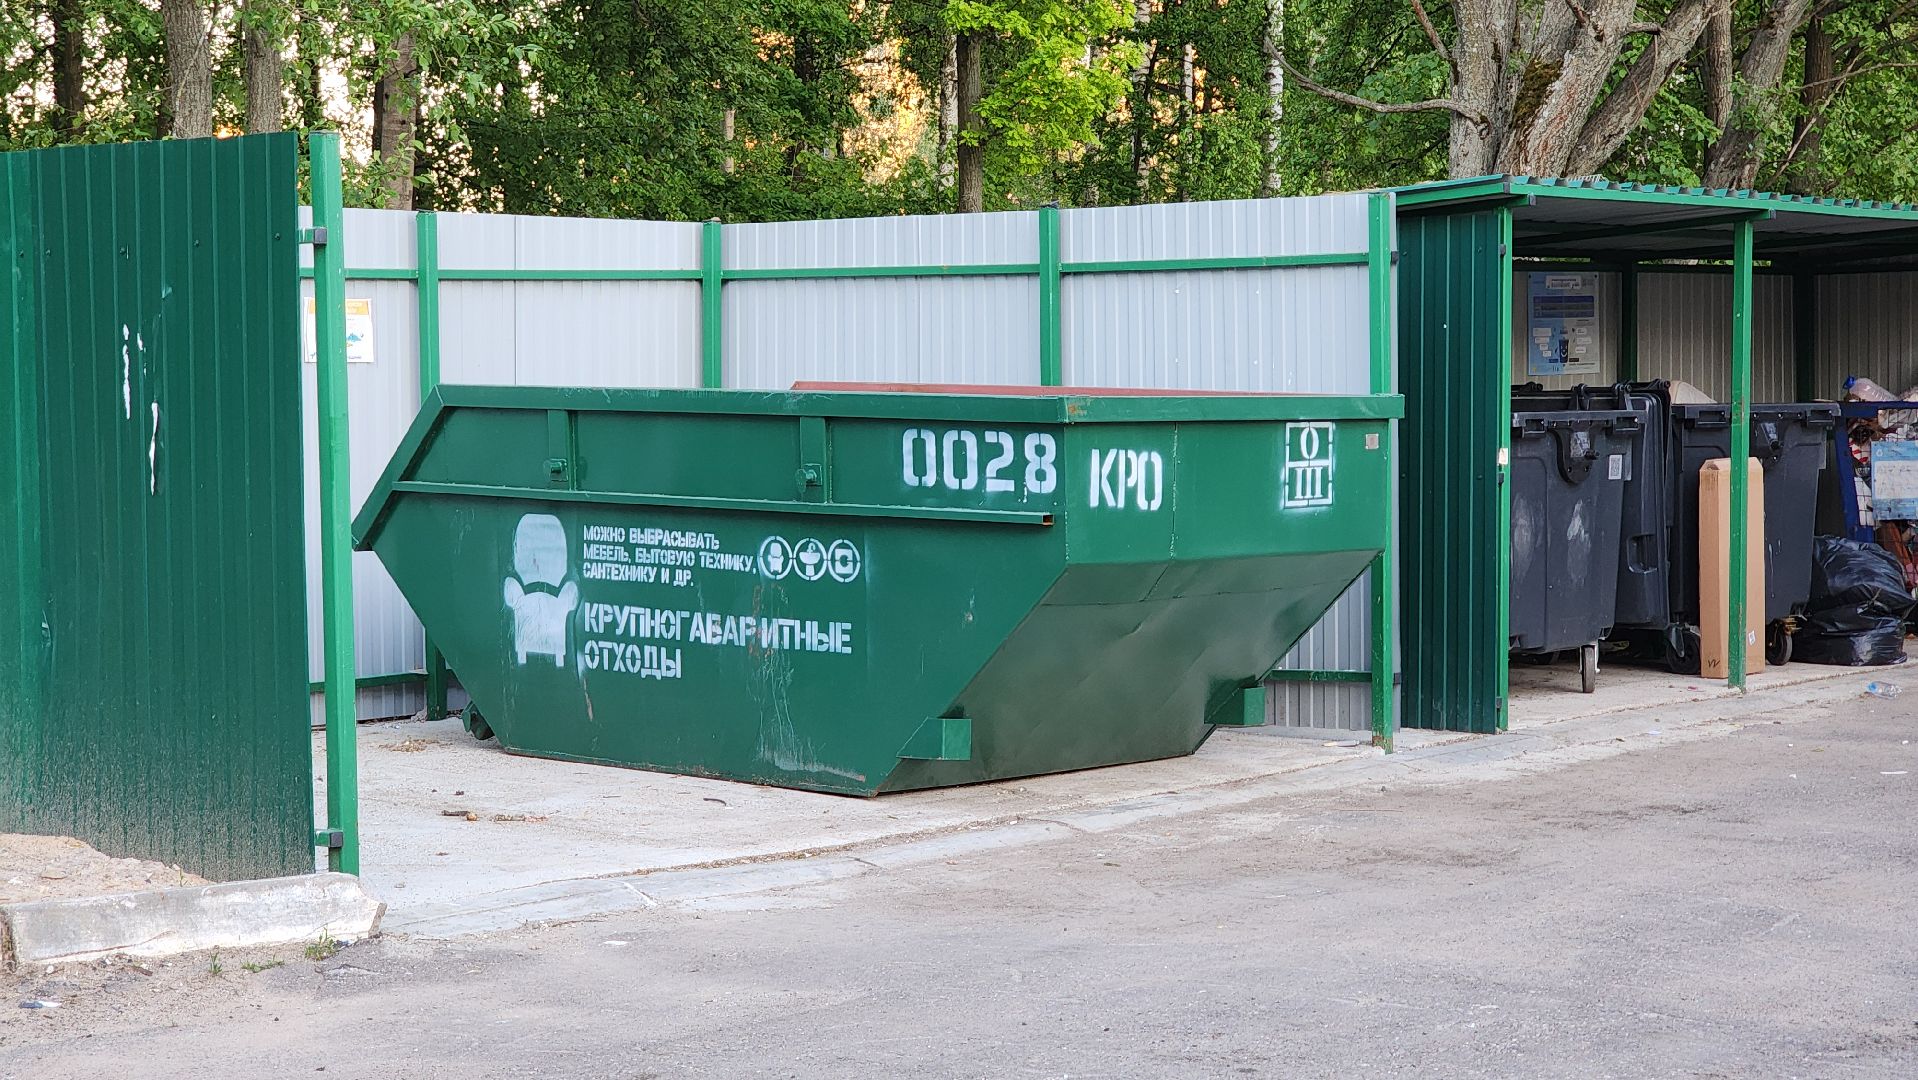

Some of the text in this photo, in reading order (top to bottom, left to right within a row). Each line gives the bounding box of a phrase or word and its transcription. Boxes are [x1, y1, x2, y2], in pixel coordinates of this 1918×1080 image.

[902, 428, 1057, 494] 0028
[1089, 448, 1162, 511] КРО
[583, 525, 720, 550] МОЖНО ВЫБРАСЫВАТЬ
[583, 543, 757, 575] МЕБЕЛЬ, БЫТОВУЮ ТЕХНИКУ,
[583, 562, 694, 587] САНТЕХНИКУ И ДР.
[584, 602, 853, 654] КРУПНОГАБАРИТНЫЕ
[584, 640, 683, 680] ОТХОДЫ
